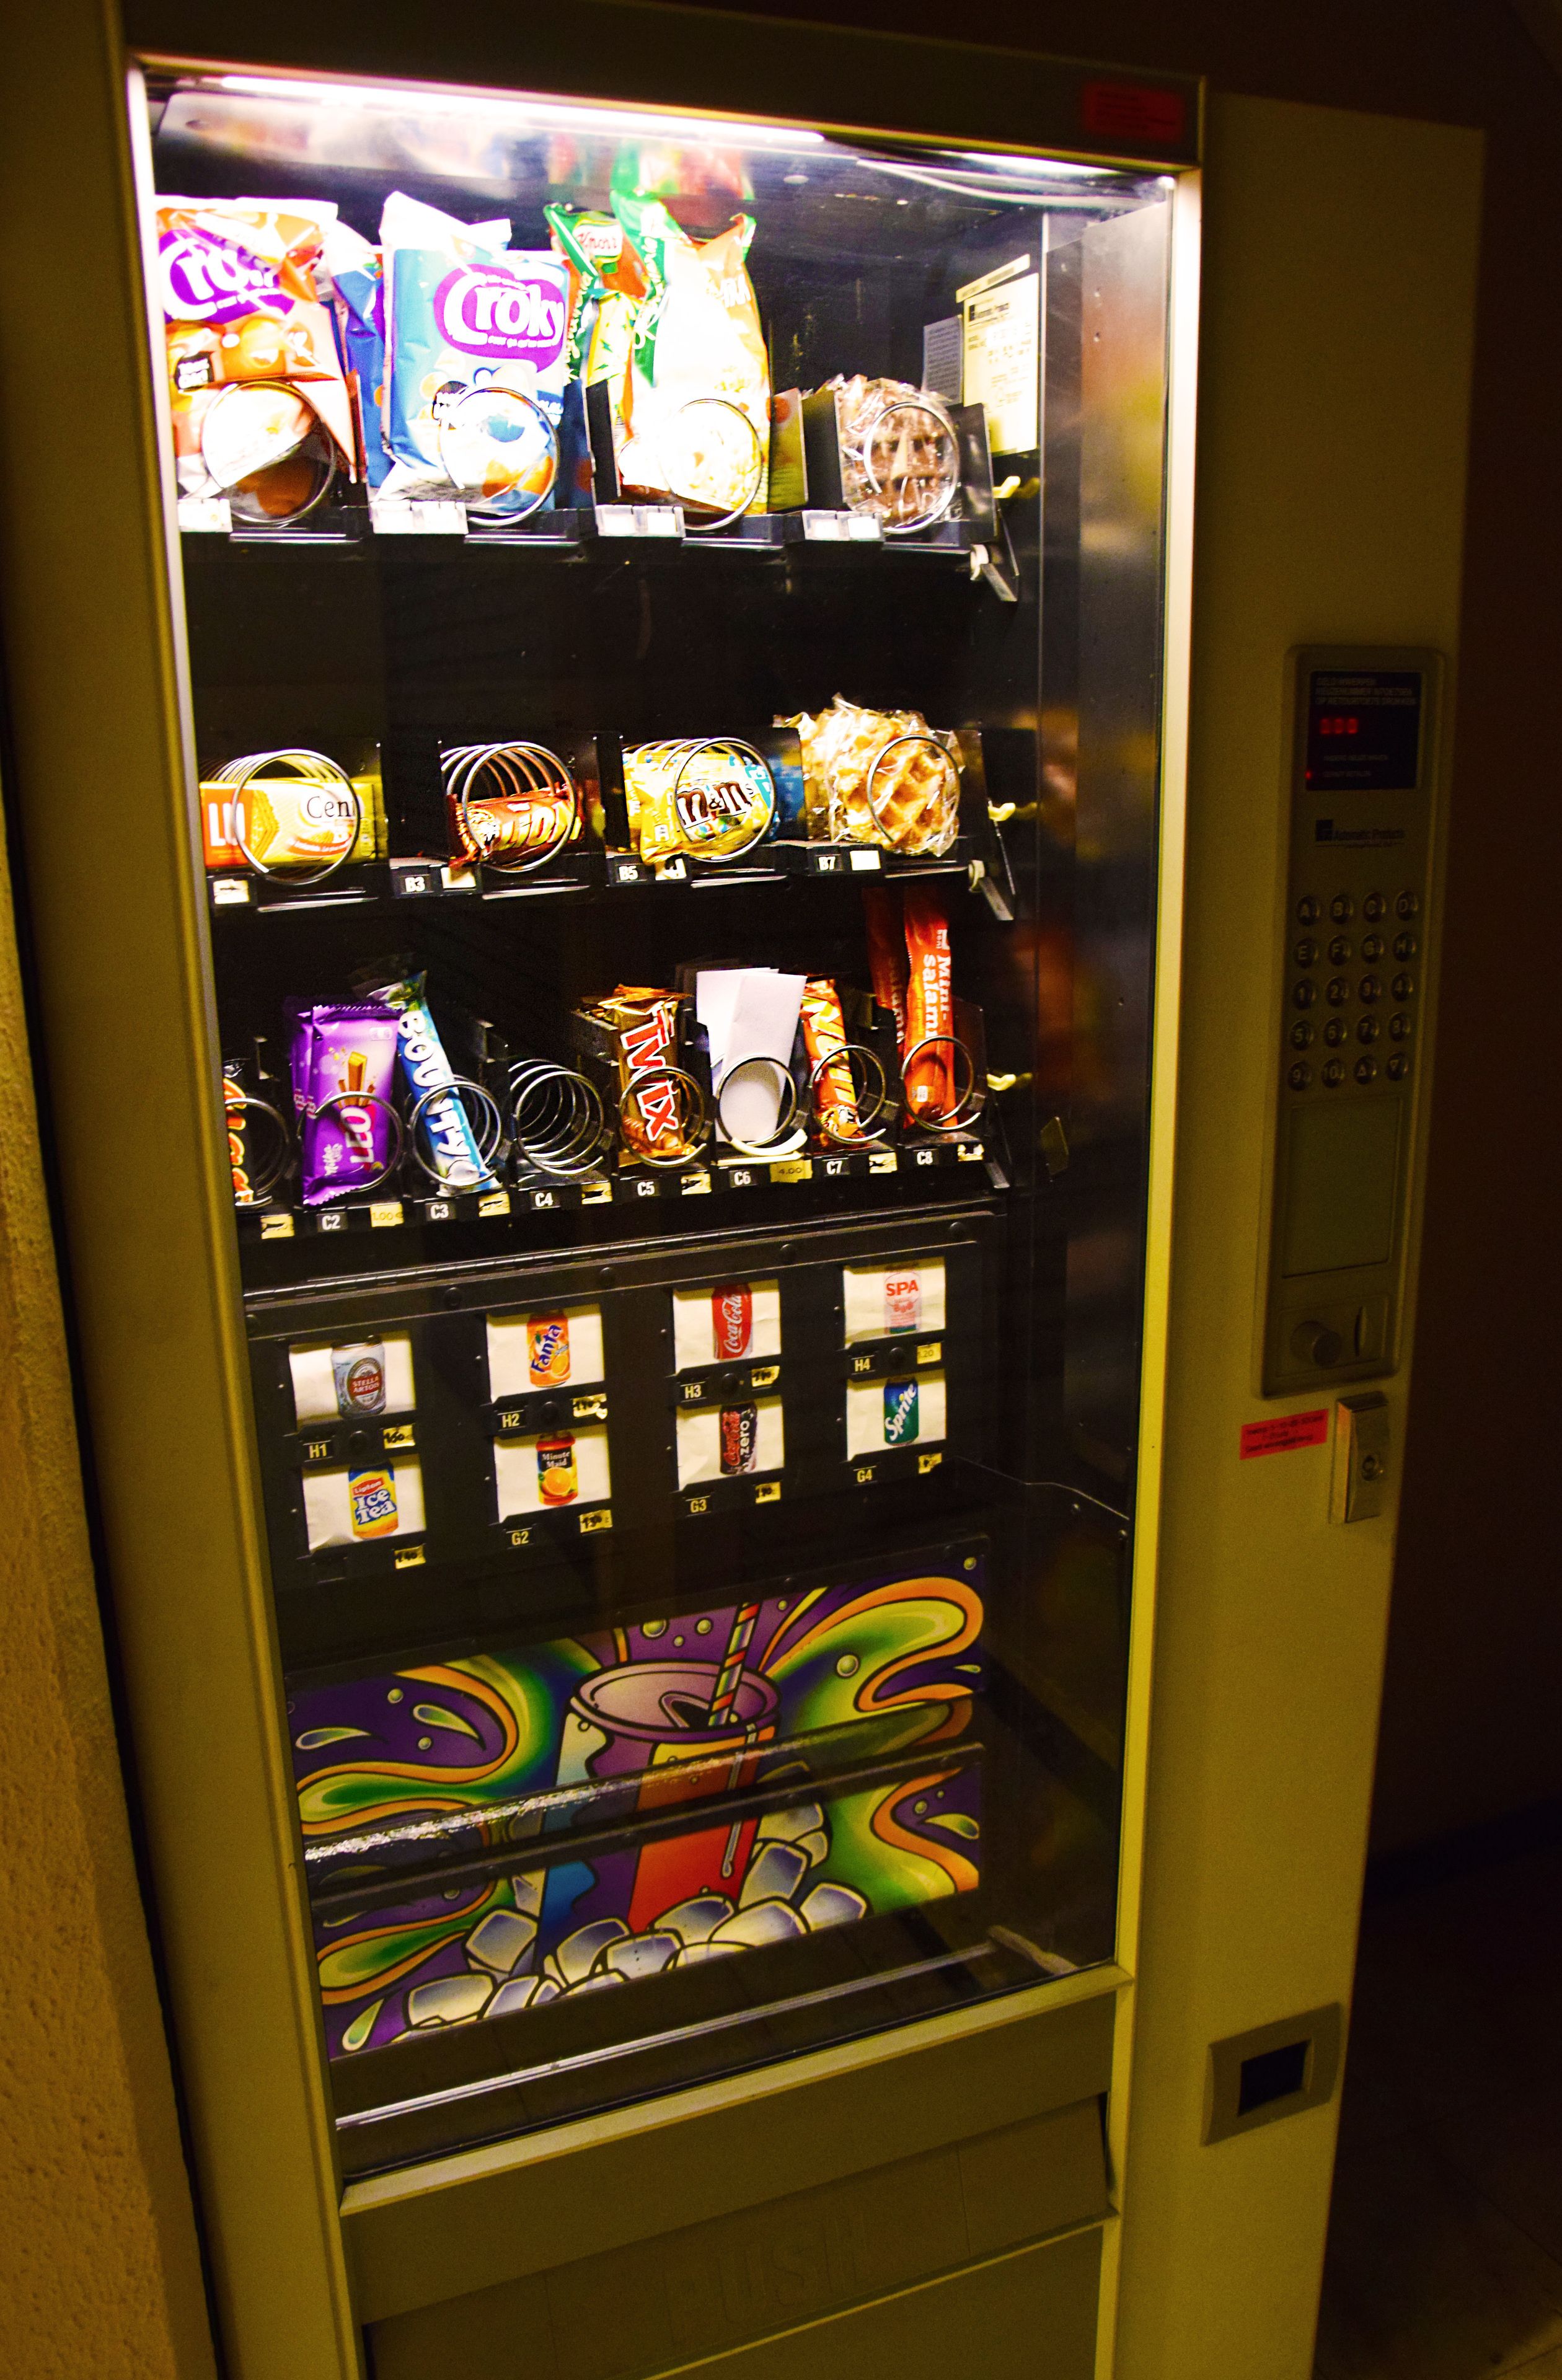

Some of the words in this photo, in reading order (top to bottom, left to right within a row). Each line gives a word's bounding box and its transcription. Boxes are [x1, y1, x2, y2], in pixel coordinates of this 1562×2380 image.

[576, 231, 617, 250] Knorr
[157, 236, 277, 320] Cro
[443, 271, 563, 347] Croky
[307, 795, 356, 819] Cen
[208, 802, 246, 847] LU
[619, 865, 638, 881] B5
[405, 876, 425, 892] B3
[1297, 945, 1308, 960] E
[1397, 940, 1407, 953] H
[922, 953, 940, 1039] salami
[1330, 984, 1339, 999] 2
[1395, 980, 1404, 993] 4
[397, 1010, 472, 1158] BOUNTY
[620, 1009, 679, 1142] TWIX
[340, 1105, 376, 1163] LEO
[917, 1150, 933, 1165] C8
[778, 1166, 803, 1176] 4.00
[826, 1160, 842, 1175] C7
[734, 1171, 751, 1186] C6
[637, 1181, 655, 1197] C5
[535, 1192, 554, 1207] C4
[430, 1203, 449, 1219] C3
[321, 1214, 342, 1231] C2
[885, 1279, 919, 1297] SPA
[531, 1324, 562, 1372] Fanta
[854, 1359, 871, 1373] H4
[685, 1385, 702, 1399] H3
[501, 1413, 520, 1428] H2
[883, 1383, 918, 1442] Sprite
[739, 1419, 750, 1456] zero
[309, 1443, 327, 1459] H1
[857, 1469, 873, 1483] G4
[355, 1489, 390, 1510] Ice
[689, 1499, 707, 1513] G3
[356, 1501, 396, 1524] Tea
[511, 1531, 529, 1546] G2
